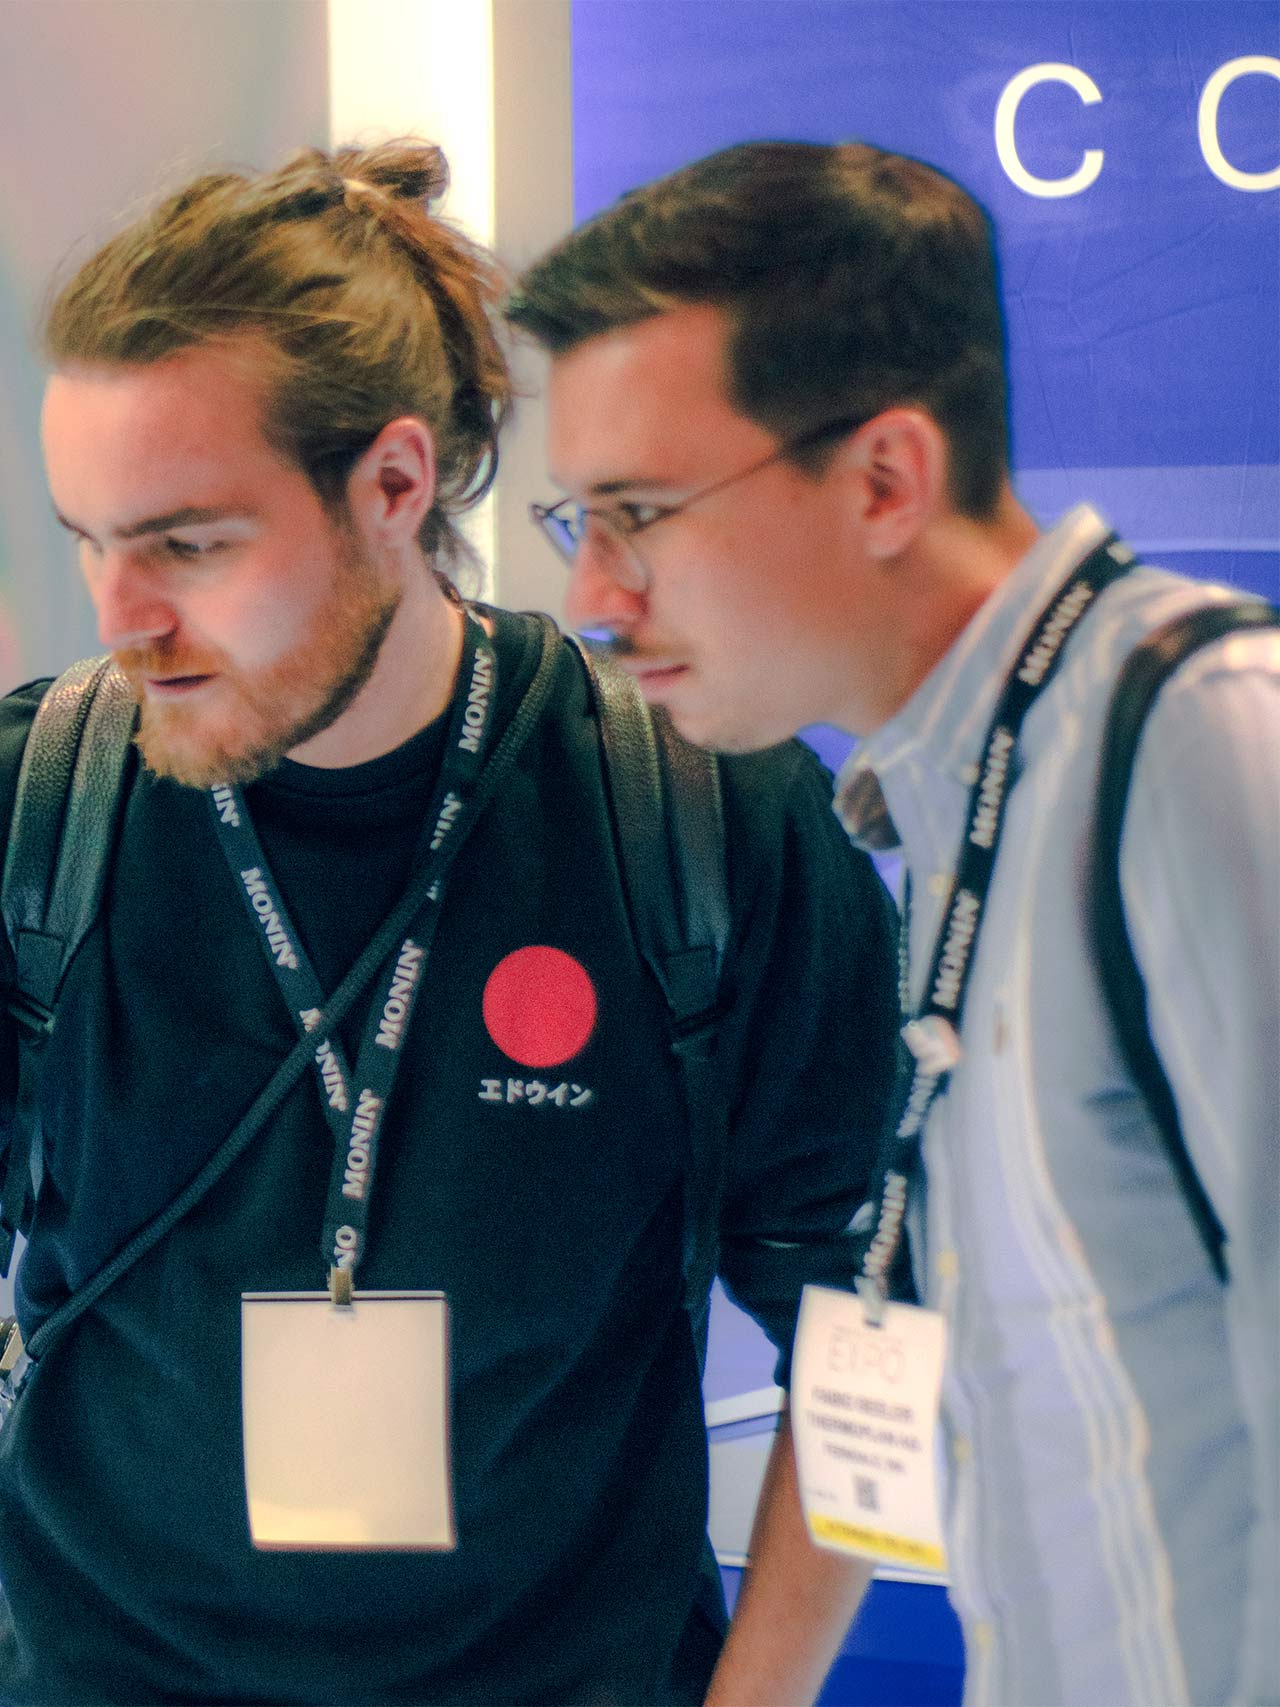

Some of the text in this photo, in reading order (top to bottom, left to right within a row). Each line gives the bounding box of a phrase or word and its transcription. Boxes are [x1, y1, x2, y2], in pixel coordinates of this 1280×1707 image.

[458, 647, 492, 754] MONIN
[240, 866, 299, 970] MONIN
[375, 937, 424, 1050] MONIN
[341, 1087, 382, 1199] MONIN
